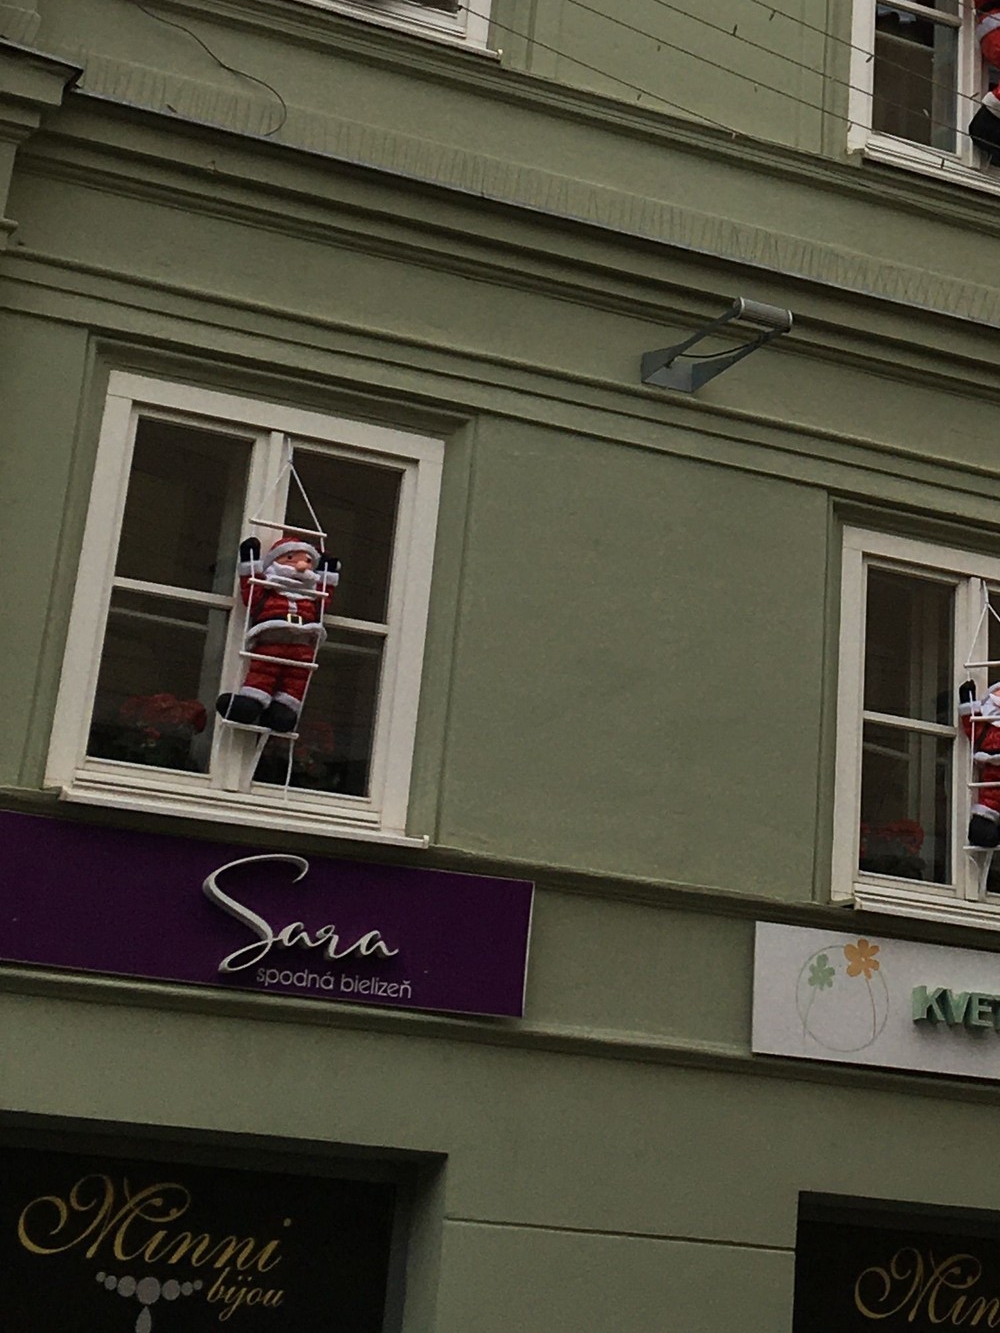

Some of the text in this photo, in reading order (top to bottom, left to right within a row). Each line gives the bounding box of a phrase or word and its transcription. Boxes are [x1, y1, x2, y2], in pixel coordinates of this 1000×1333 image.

[202, 853, 400, 974] Sara
[256, 967, 412, 999] spodná bielizeň
[17, 1172, 292, 1274] Minni
[206, 1266, 286, 1322] bijou
